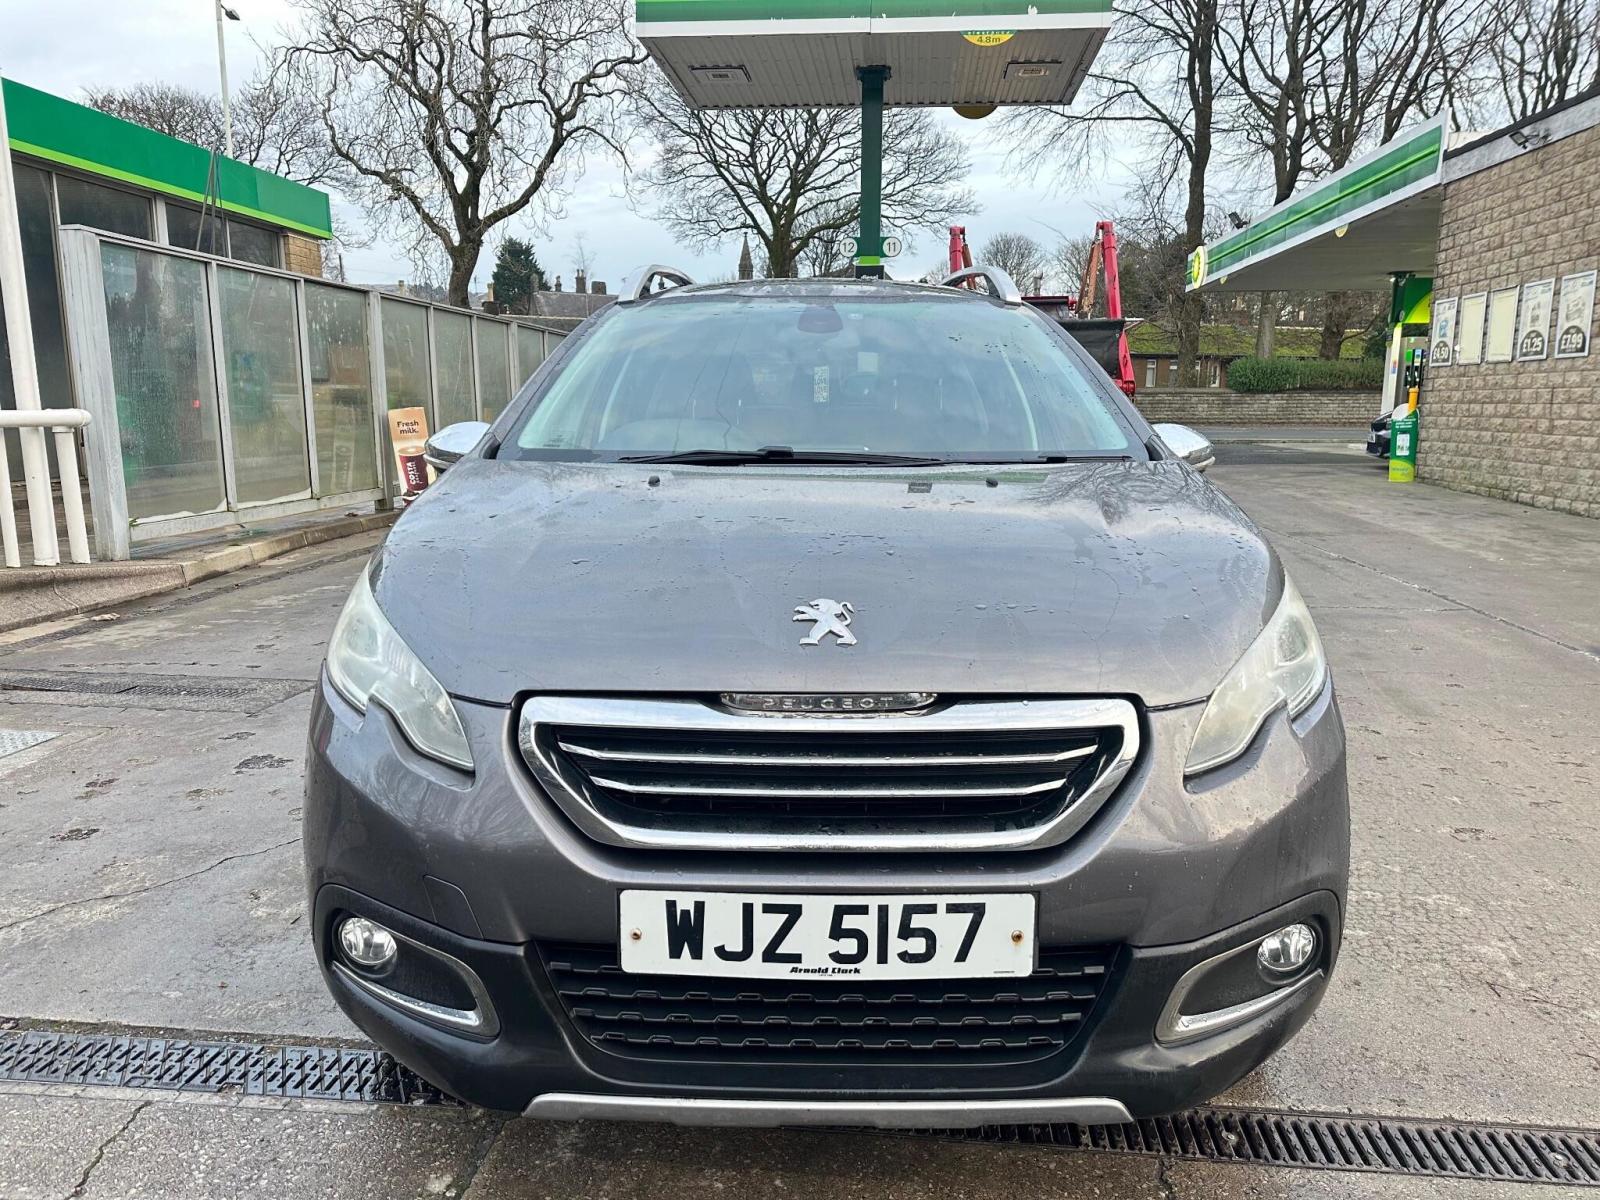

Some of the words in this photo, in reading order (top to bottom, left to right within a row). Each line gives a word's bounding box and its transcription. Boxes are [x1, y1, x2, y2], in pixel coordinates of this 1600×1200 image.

[842, 242, 855, 253] 12
[886, 242, 897, 253] 11
[1523, 337, 1543, 352] £1.25
[1561, 333, 1583, 349] £7.99
[397, 420, 419, 428] Fresh
[399, 427, 419, 435] milk.
[406, 461, 416, 485] COSTA
[763, 697, 893, 709] PEUGEOT
[665, 899, 803, 964] WJZ
[828, 902, 987, 965] 5157
[789, 966, 829, 974] Arnold
